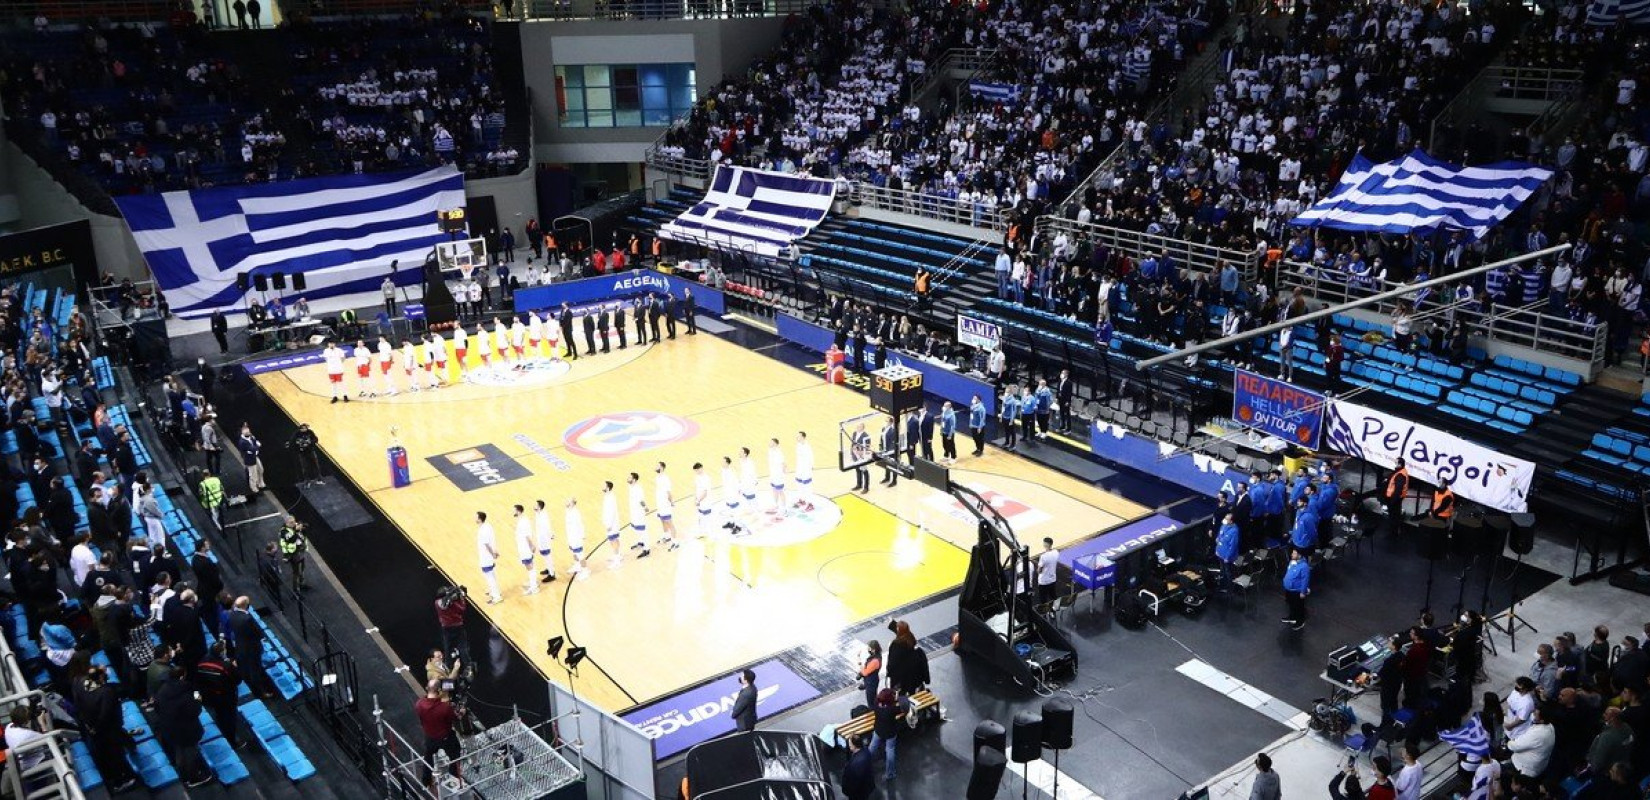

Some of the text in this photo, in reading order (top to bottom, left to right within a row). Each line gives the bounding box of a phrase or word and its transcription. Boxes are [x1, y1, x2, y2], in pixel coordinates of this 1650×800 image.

[613, 276, 663, 291] AEGEAN
[961, 318, 1000, 340] LAMIA
[1253, 411, 1297, 434] ON TOUR
[1361, 416, 1494, 488] Pelargoi
